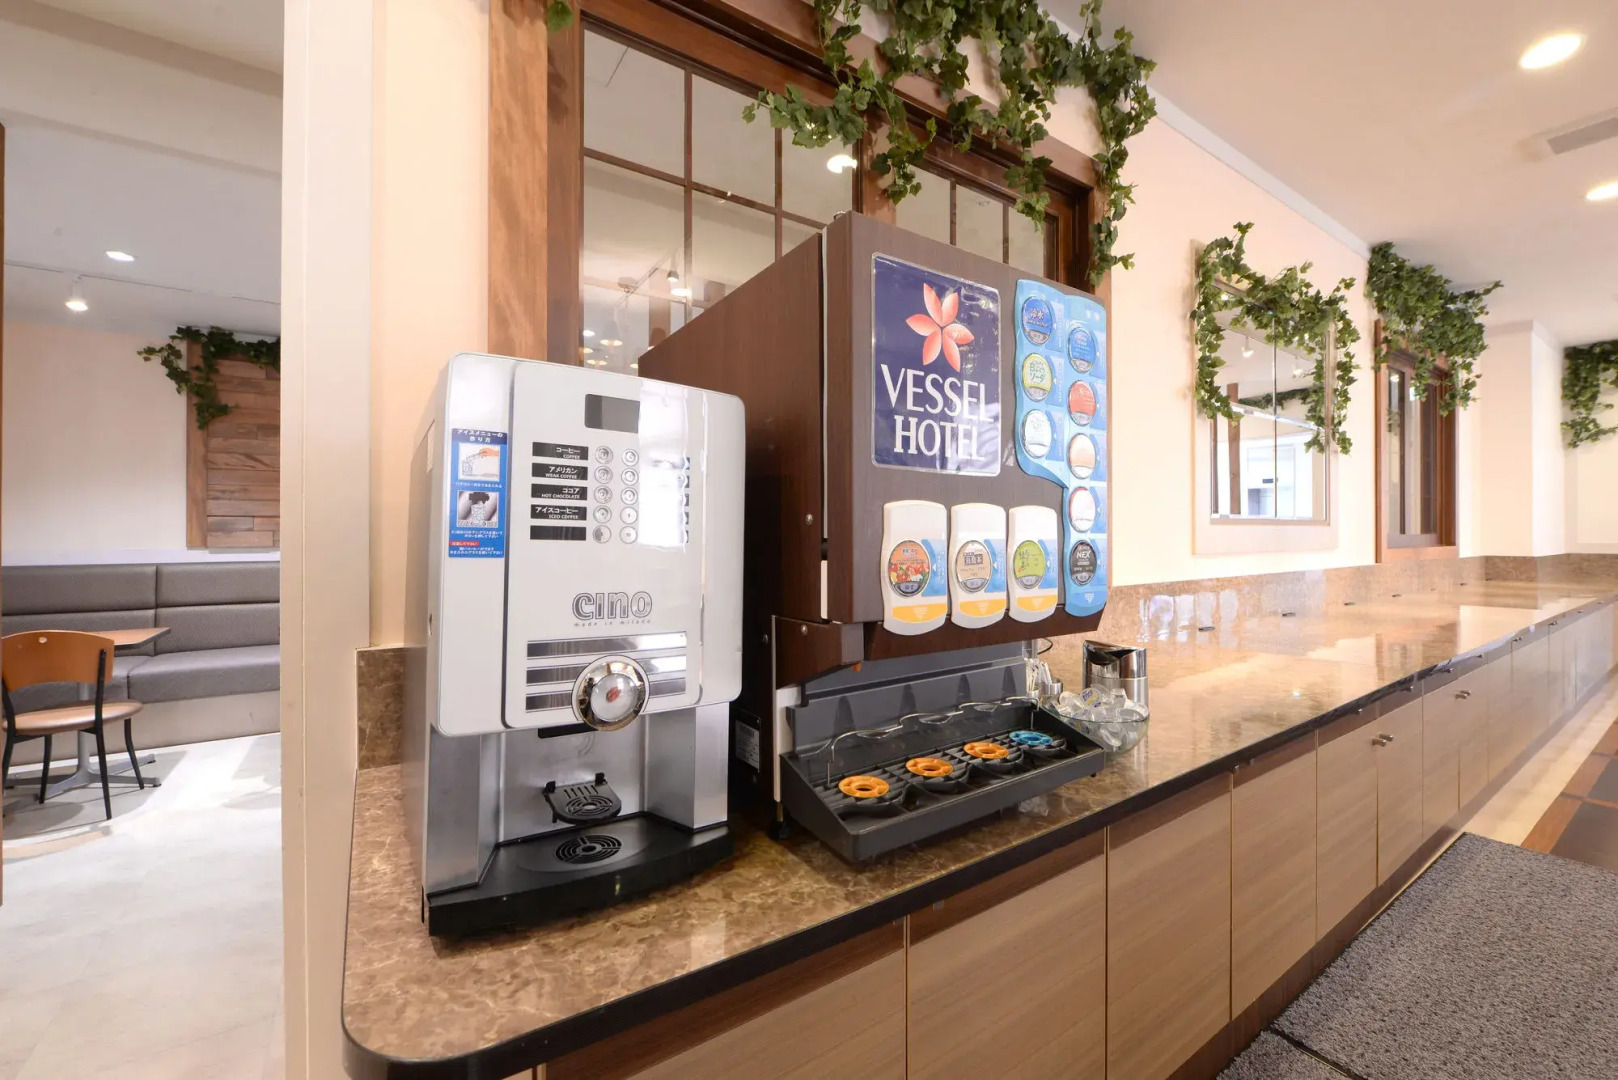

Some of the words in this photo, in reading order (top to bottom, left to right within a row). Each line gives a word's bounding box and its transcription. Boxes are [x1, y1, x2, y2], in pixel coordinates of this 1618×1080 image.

[880, 363, 995, 423] VESSEL
[893, 415, 986, 461] HOTEL
[548, 466, 578, 474] アメリカン
[535, 506, 579, 514] アイスコーヒー
[1076, 550, 1091, 559] NEX
[572, 591, 653, 620] cino
